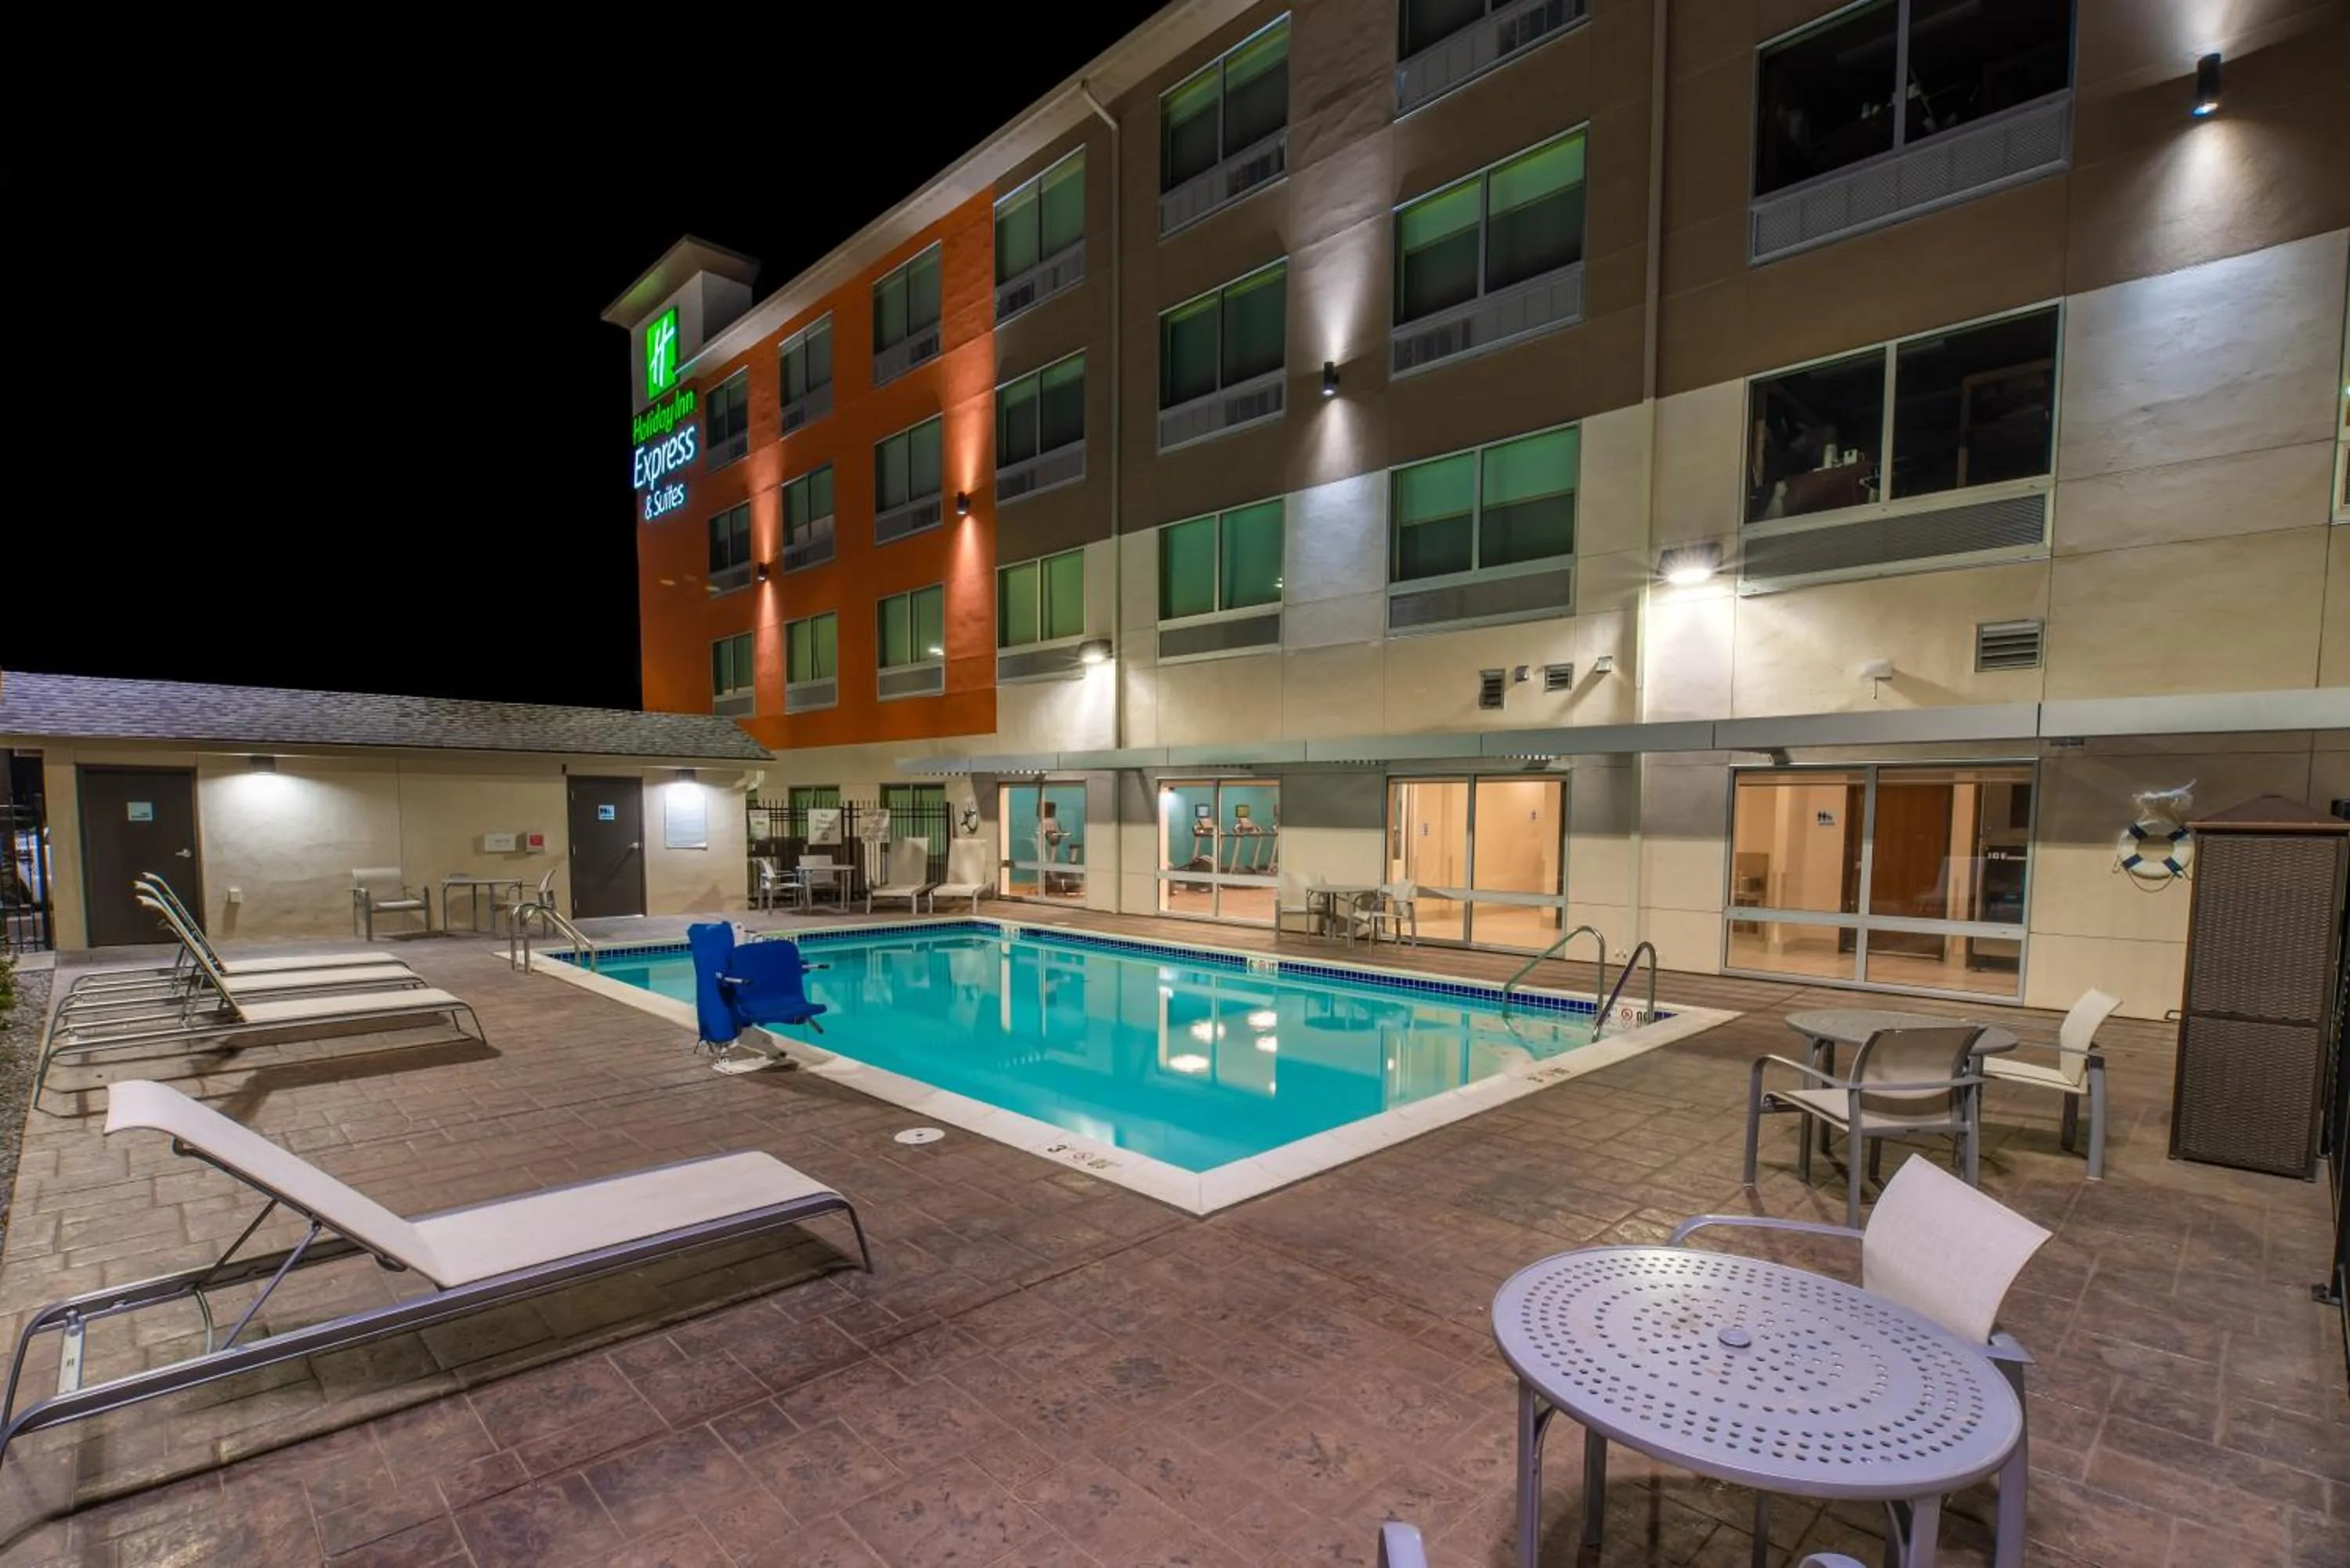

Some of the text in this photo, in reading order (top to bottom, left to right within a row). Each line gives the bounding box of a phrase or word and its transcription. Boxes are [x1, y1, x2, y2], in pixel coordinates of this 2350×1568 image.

[633, 389, 695, 446] Holiday Inn
[634, 426, 696, 490] Express
[645, 483, 684, 520] & Suites
